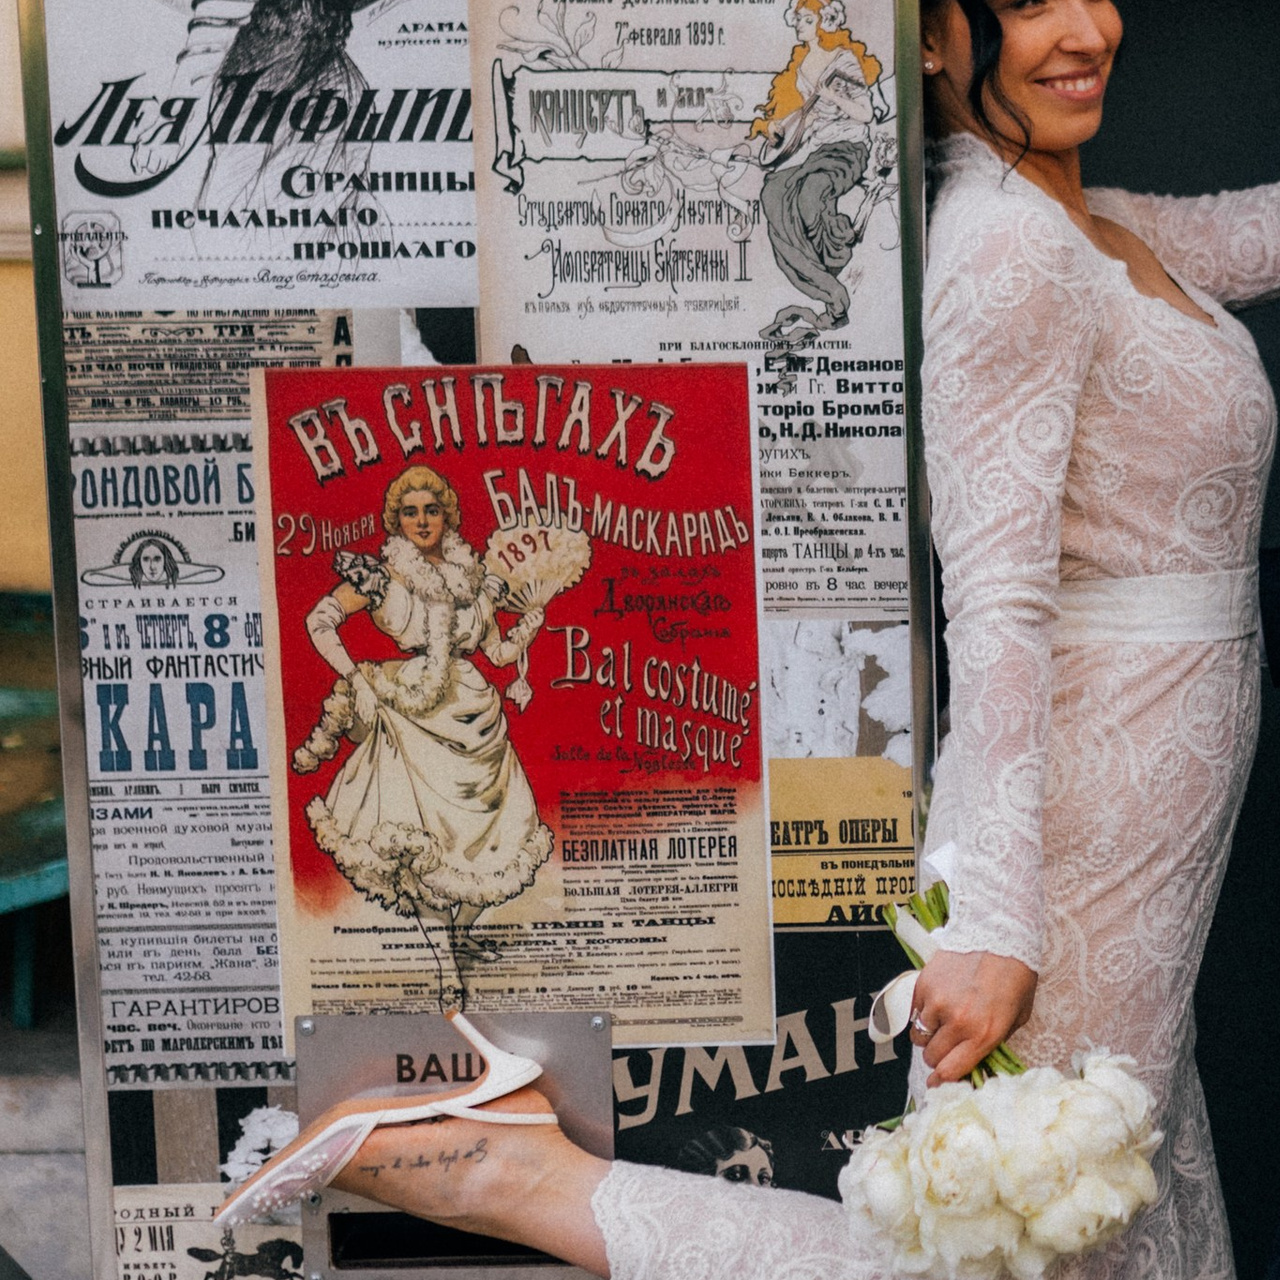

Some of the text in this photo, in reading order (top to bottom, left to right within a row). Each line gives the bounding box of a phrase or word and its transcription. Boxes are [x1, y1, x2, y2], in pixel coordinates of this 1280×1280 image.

[686, 22, 715, 46] 1899
[287, 396, 384, 487] ВЪ
[825, 422, 904, 437] Никола
[71, 459, 221, 509] ОНДОВОЙ
[497, 530, 553, 572] 1897
[792, 543, 849, 560] ТАНЦЫ
[827, 577, 838, 591] 8
[546, 625, 633, 692] Bal
[96, 681, 259, 772] КАРА
[600, 695, 624, 739] et
[839, 819, 898, 844] ОПЕРЫ
[562, 835, 737, 862] БЕЗПЛАТНАЯ ЛОТЕРЕЯ
[563, 887, 620, 897] БОЛЬШАЯ
[111, 997, 280, 1018] ГАРАНТИРОВ
